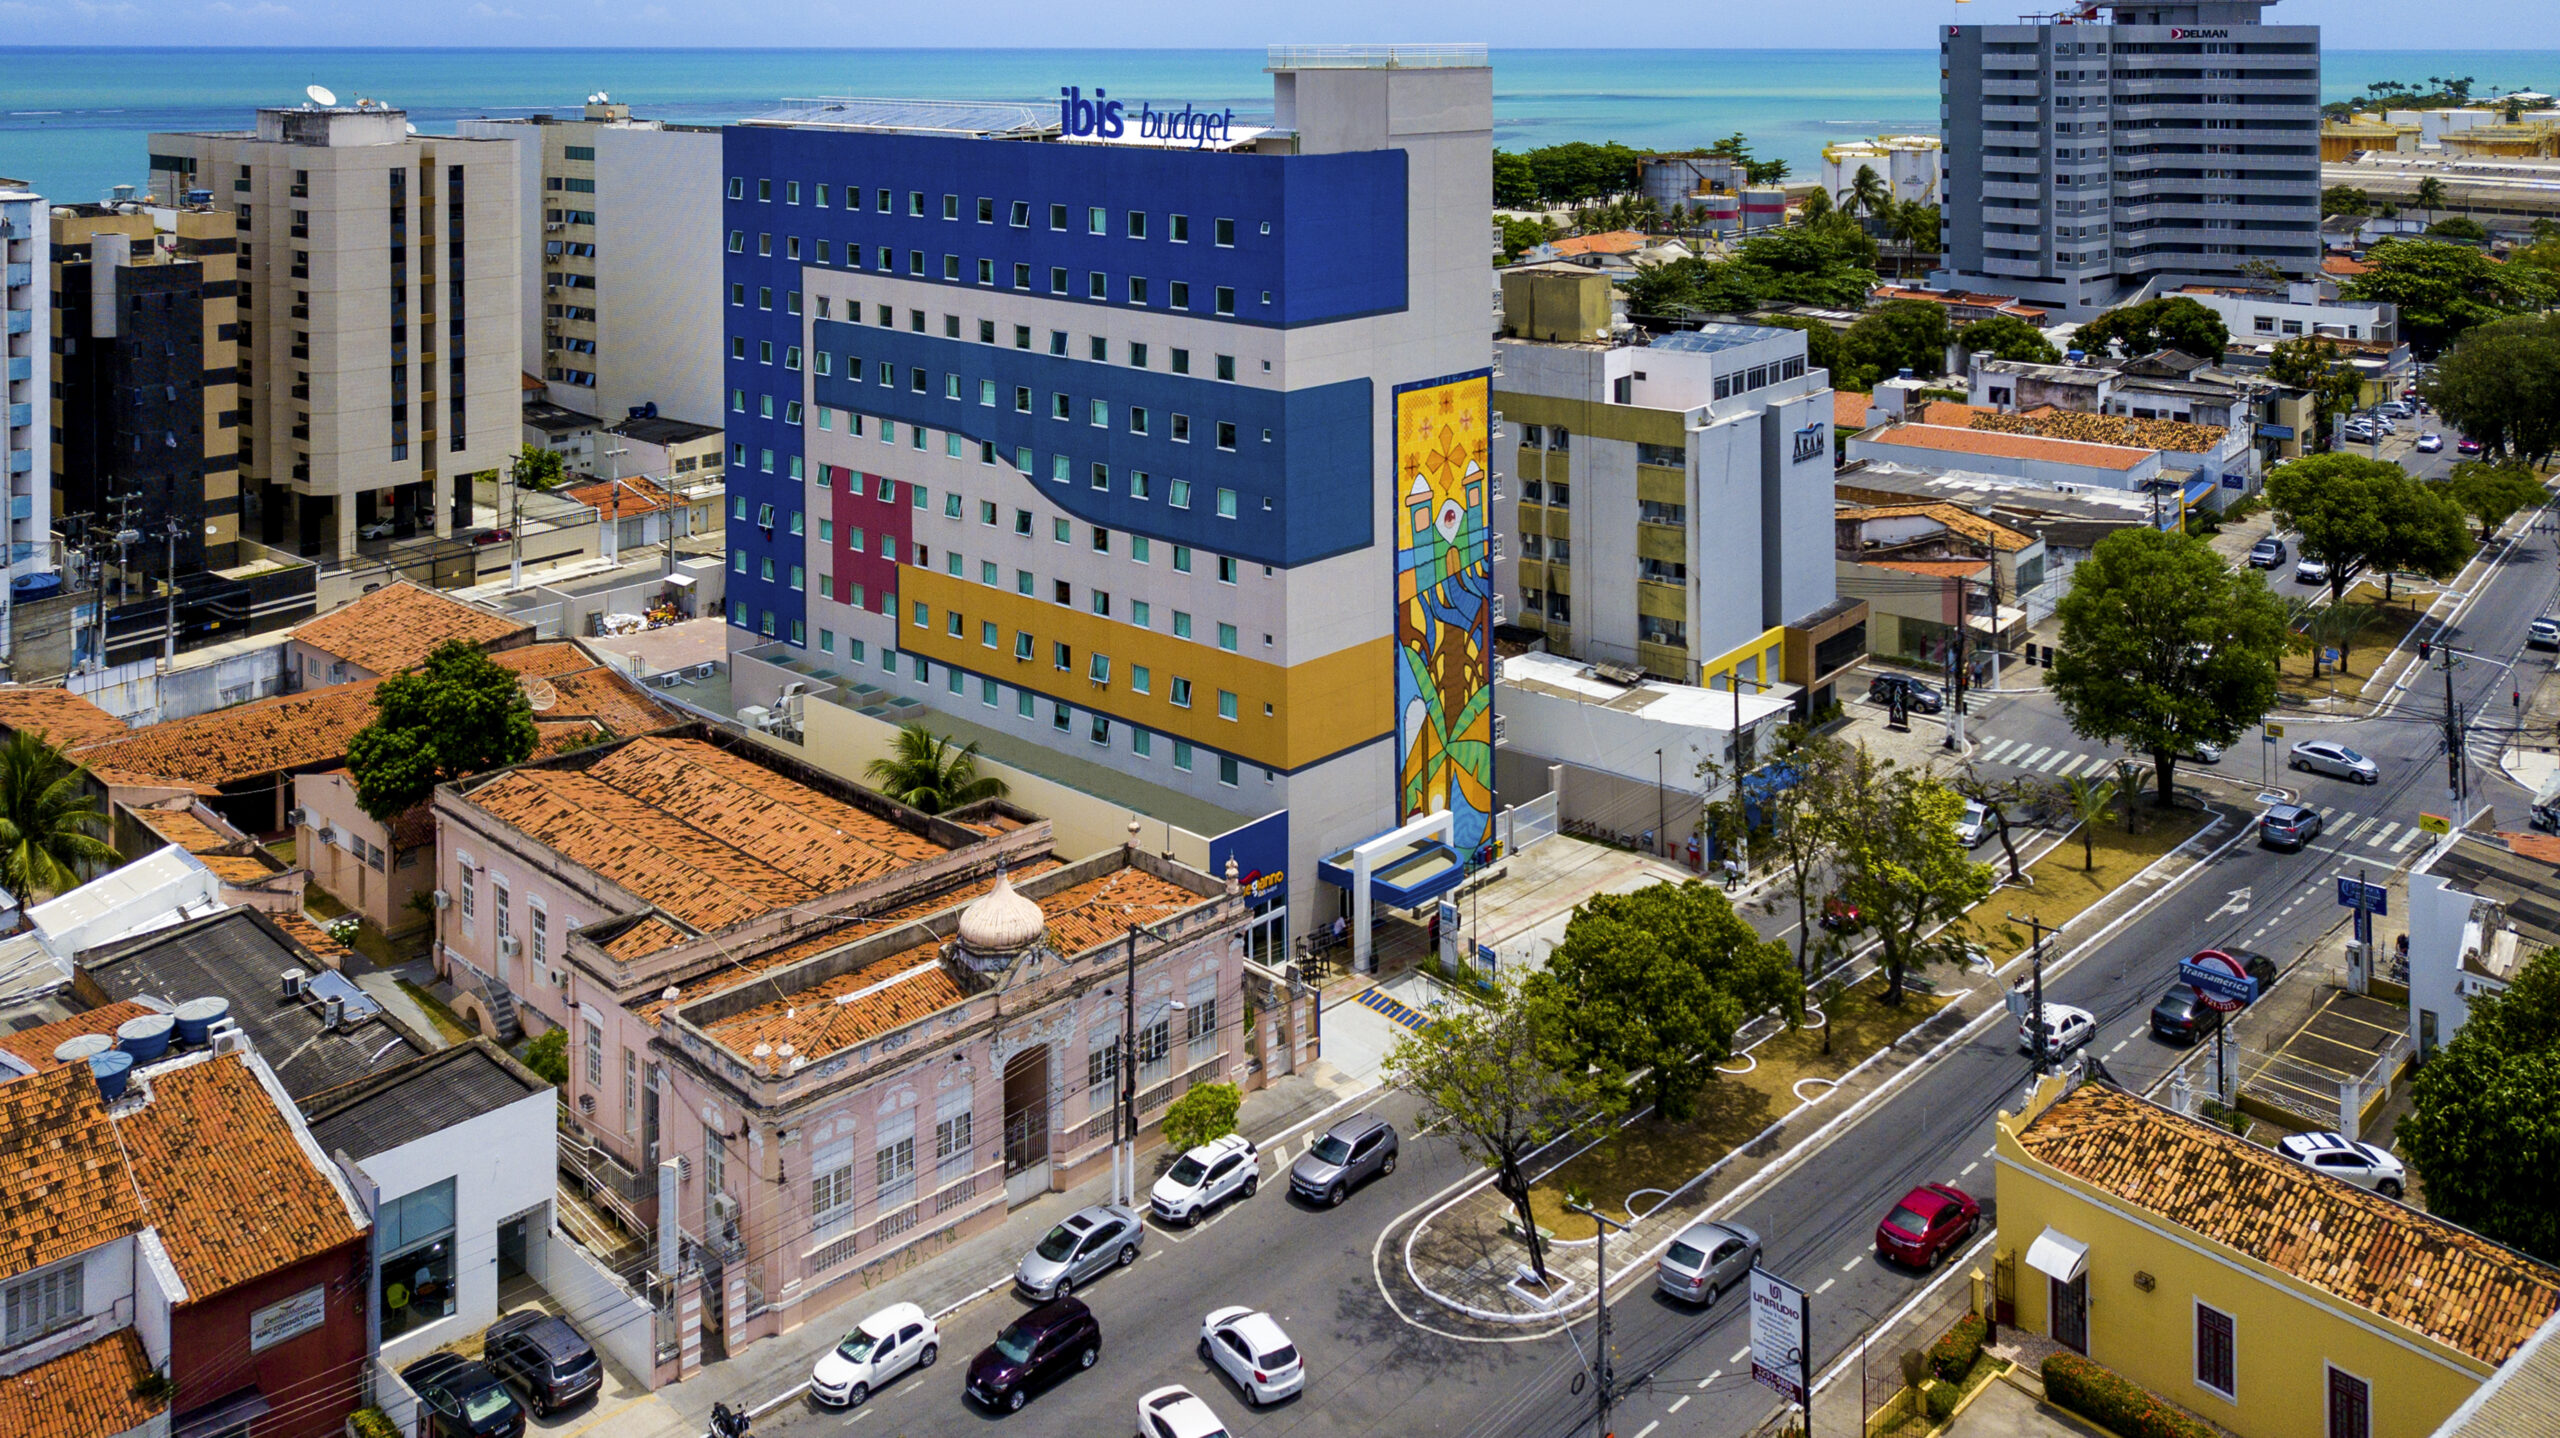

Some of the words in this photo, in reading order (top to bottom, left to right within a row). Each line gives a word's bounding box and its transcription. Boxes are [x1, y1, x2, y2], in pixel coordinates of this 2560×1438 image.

[2183, 29, 2228, 39] DELMAN
[1061, 86, 1124, 139] ibis
[1141, 101, 1235, 150] budget
[1793, 432, 1824, 458] ARAM
[1753, 1290, 1800, 1321] UNIAUDIO
